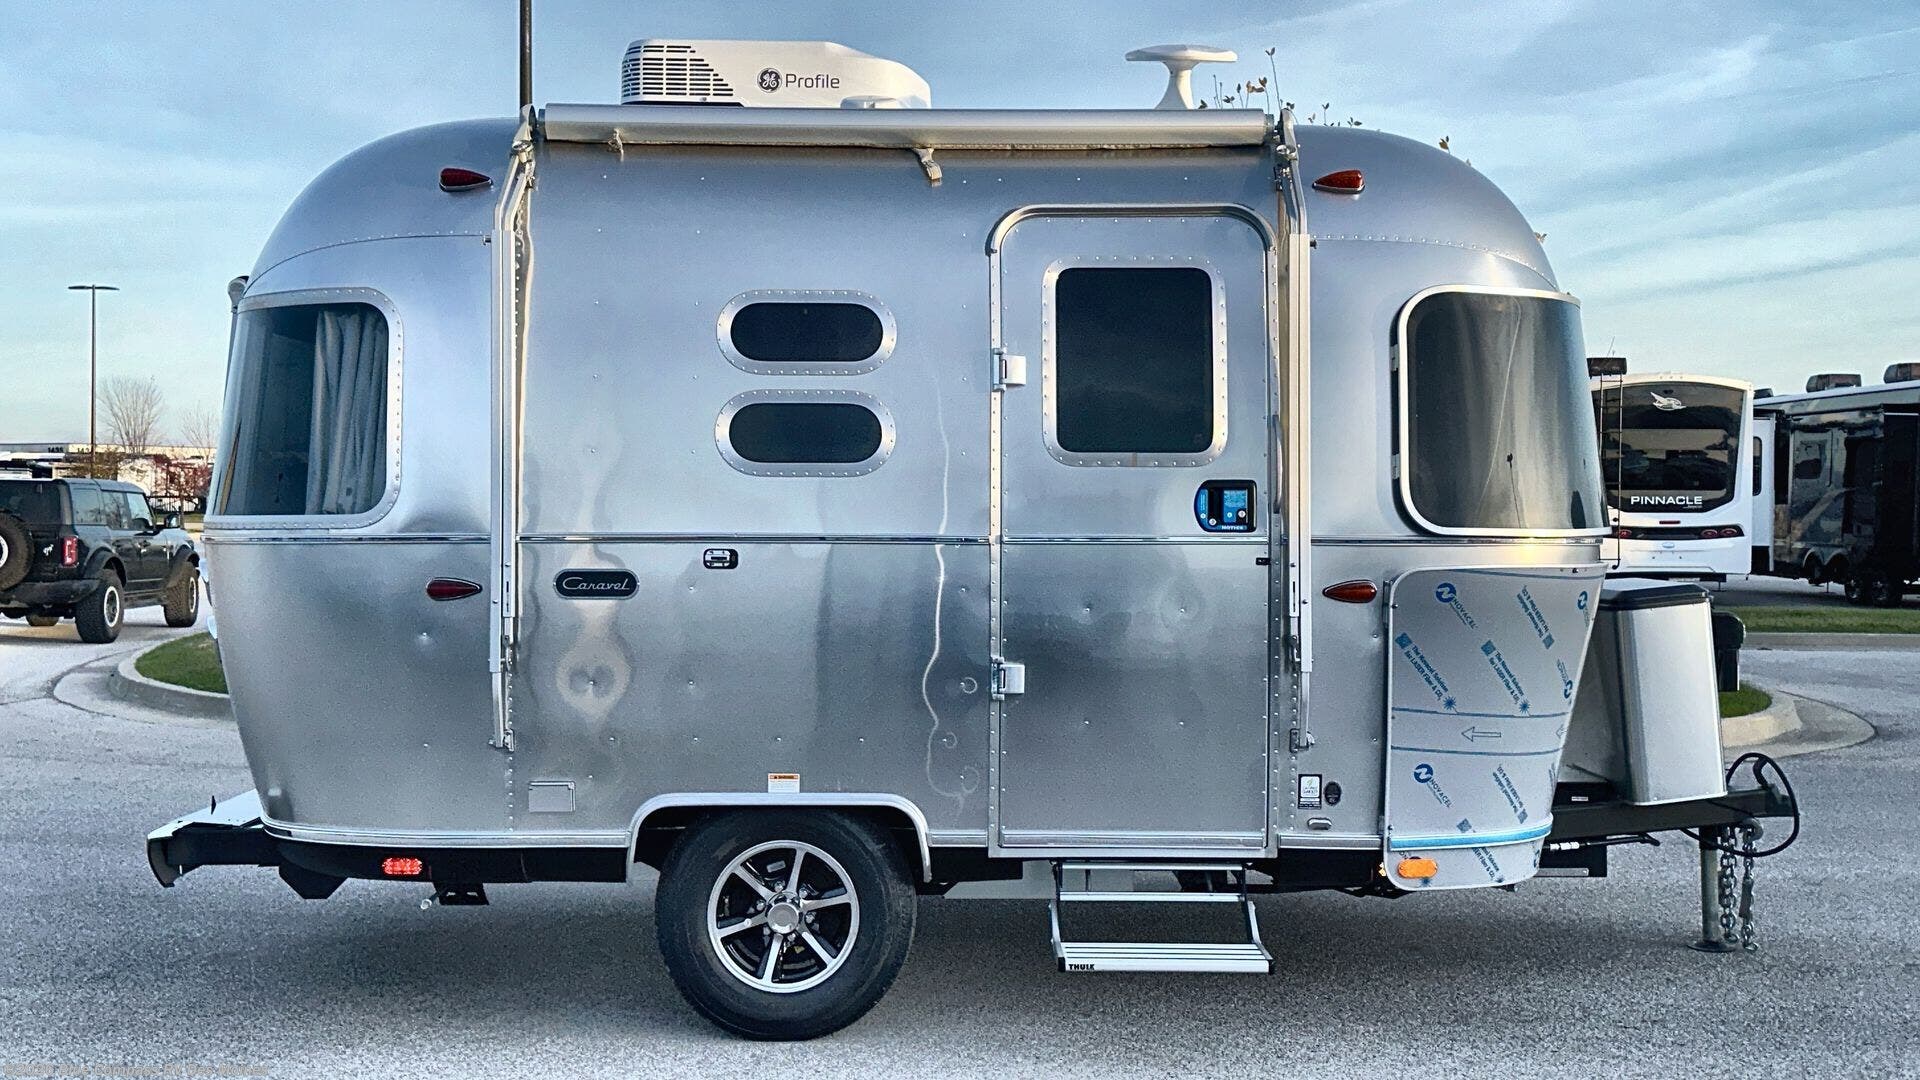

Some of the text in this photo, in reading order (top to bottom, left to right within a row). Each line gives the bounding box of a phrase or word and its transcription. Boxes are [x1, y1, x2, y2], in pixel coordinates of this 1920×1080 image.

[785, 73, 840, 89] Profile
[1630, 495, 1703, 505] PINNACLE
[562, 576, 630, 590] Caravel
